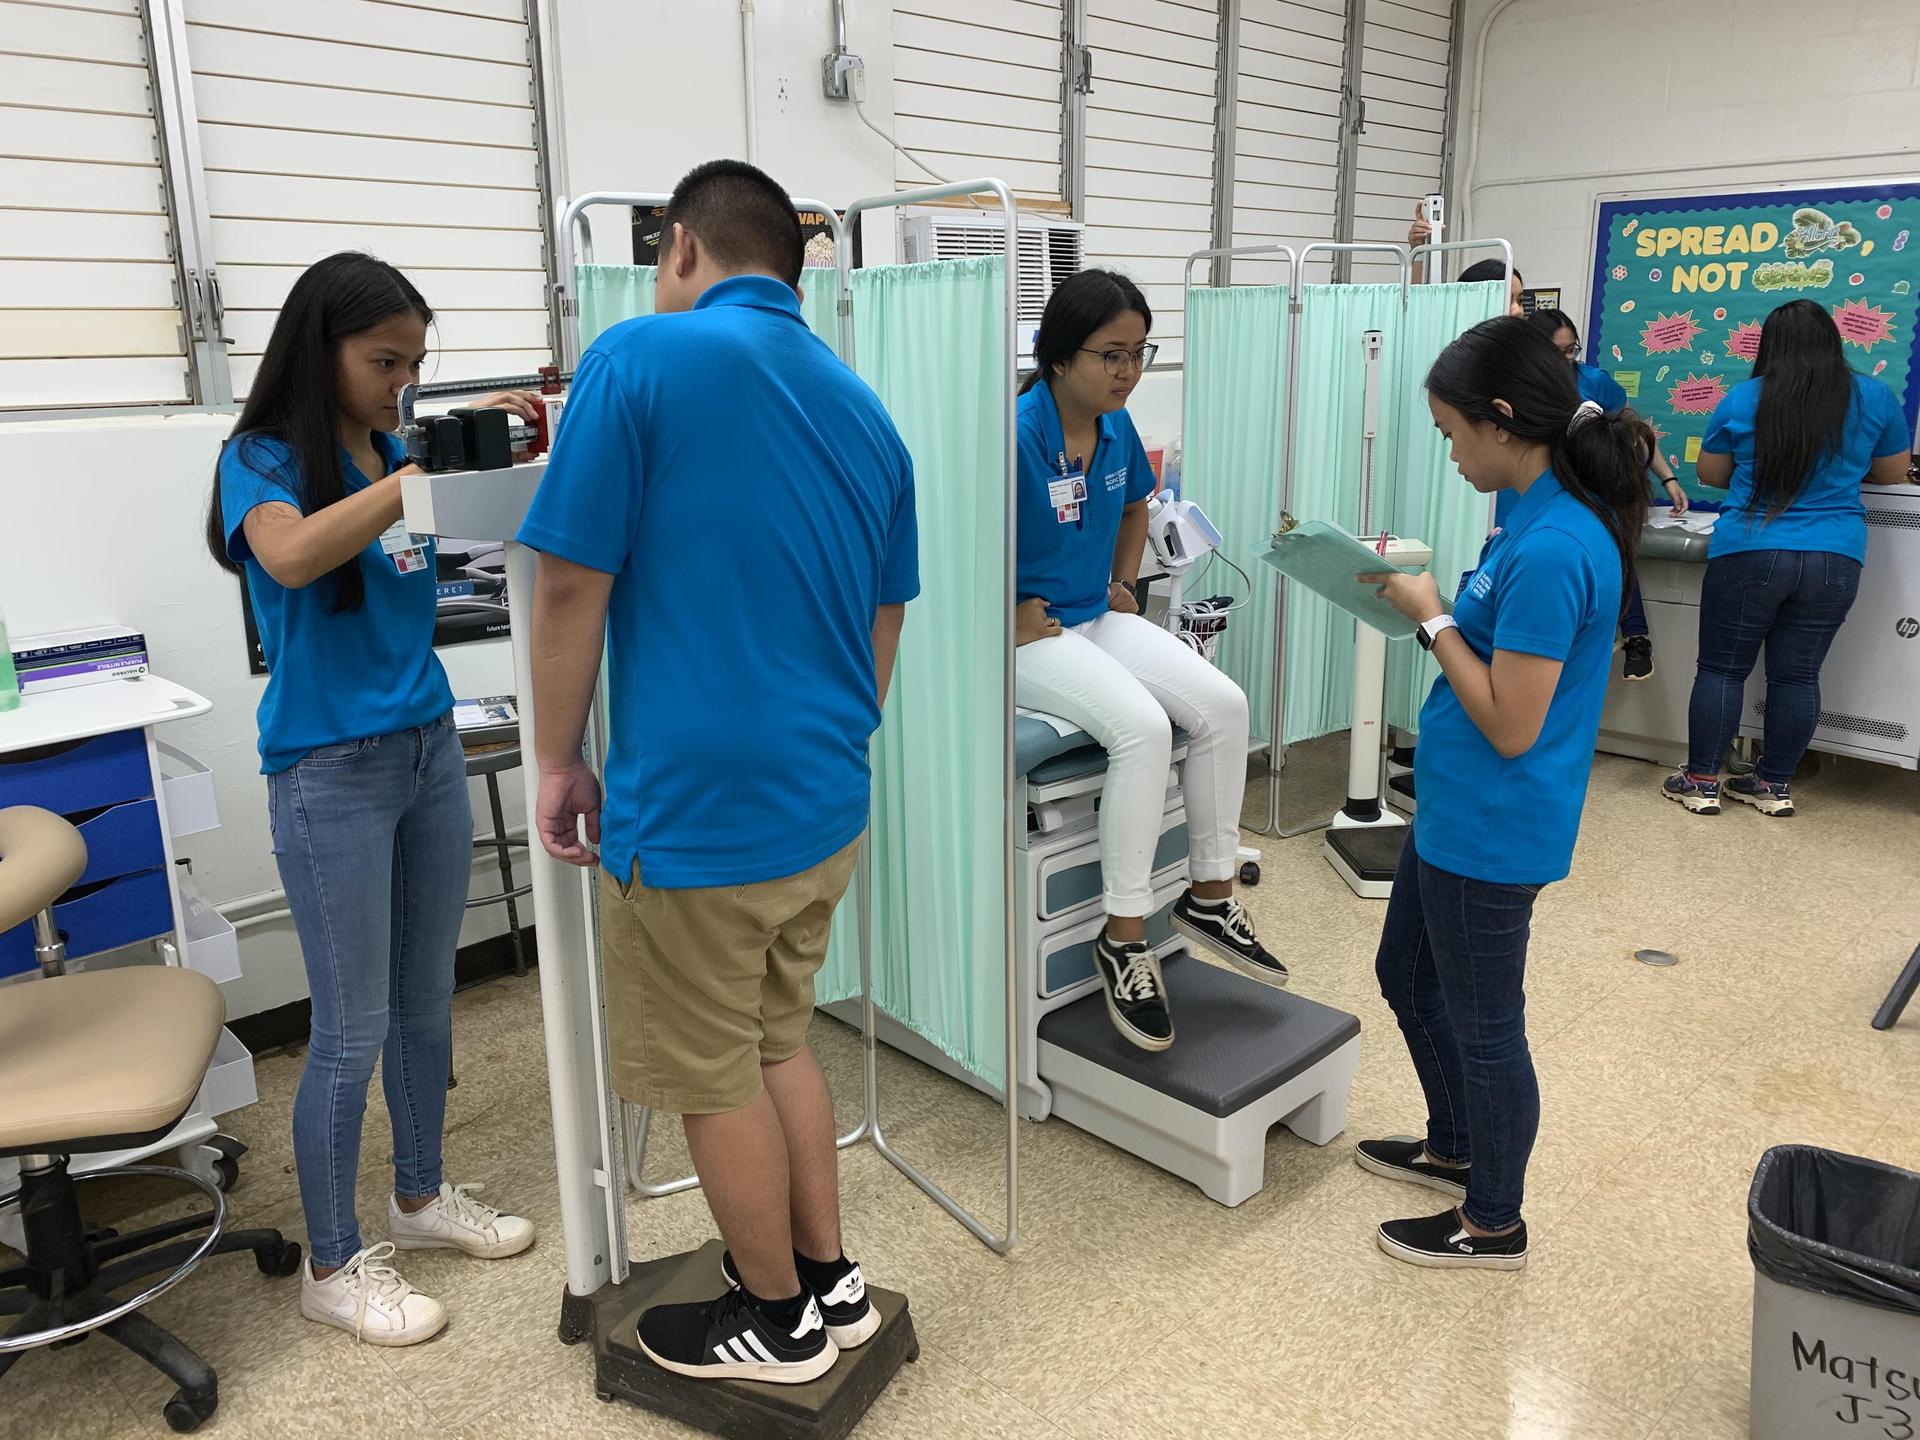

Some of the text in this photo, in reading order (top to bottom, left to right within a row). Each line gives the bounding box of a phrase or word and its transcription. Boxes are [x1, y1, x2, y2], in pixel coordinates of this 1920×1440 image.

[1636, 222, 1779, 257] SPREAD
[1672, 262, 1749, 293] NOT
[1897, 617, 1920, 639] hp
